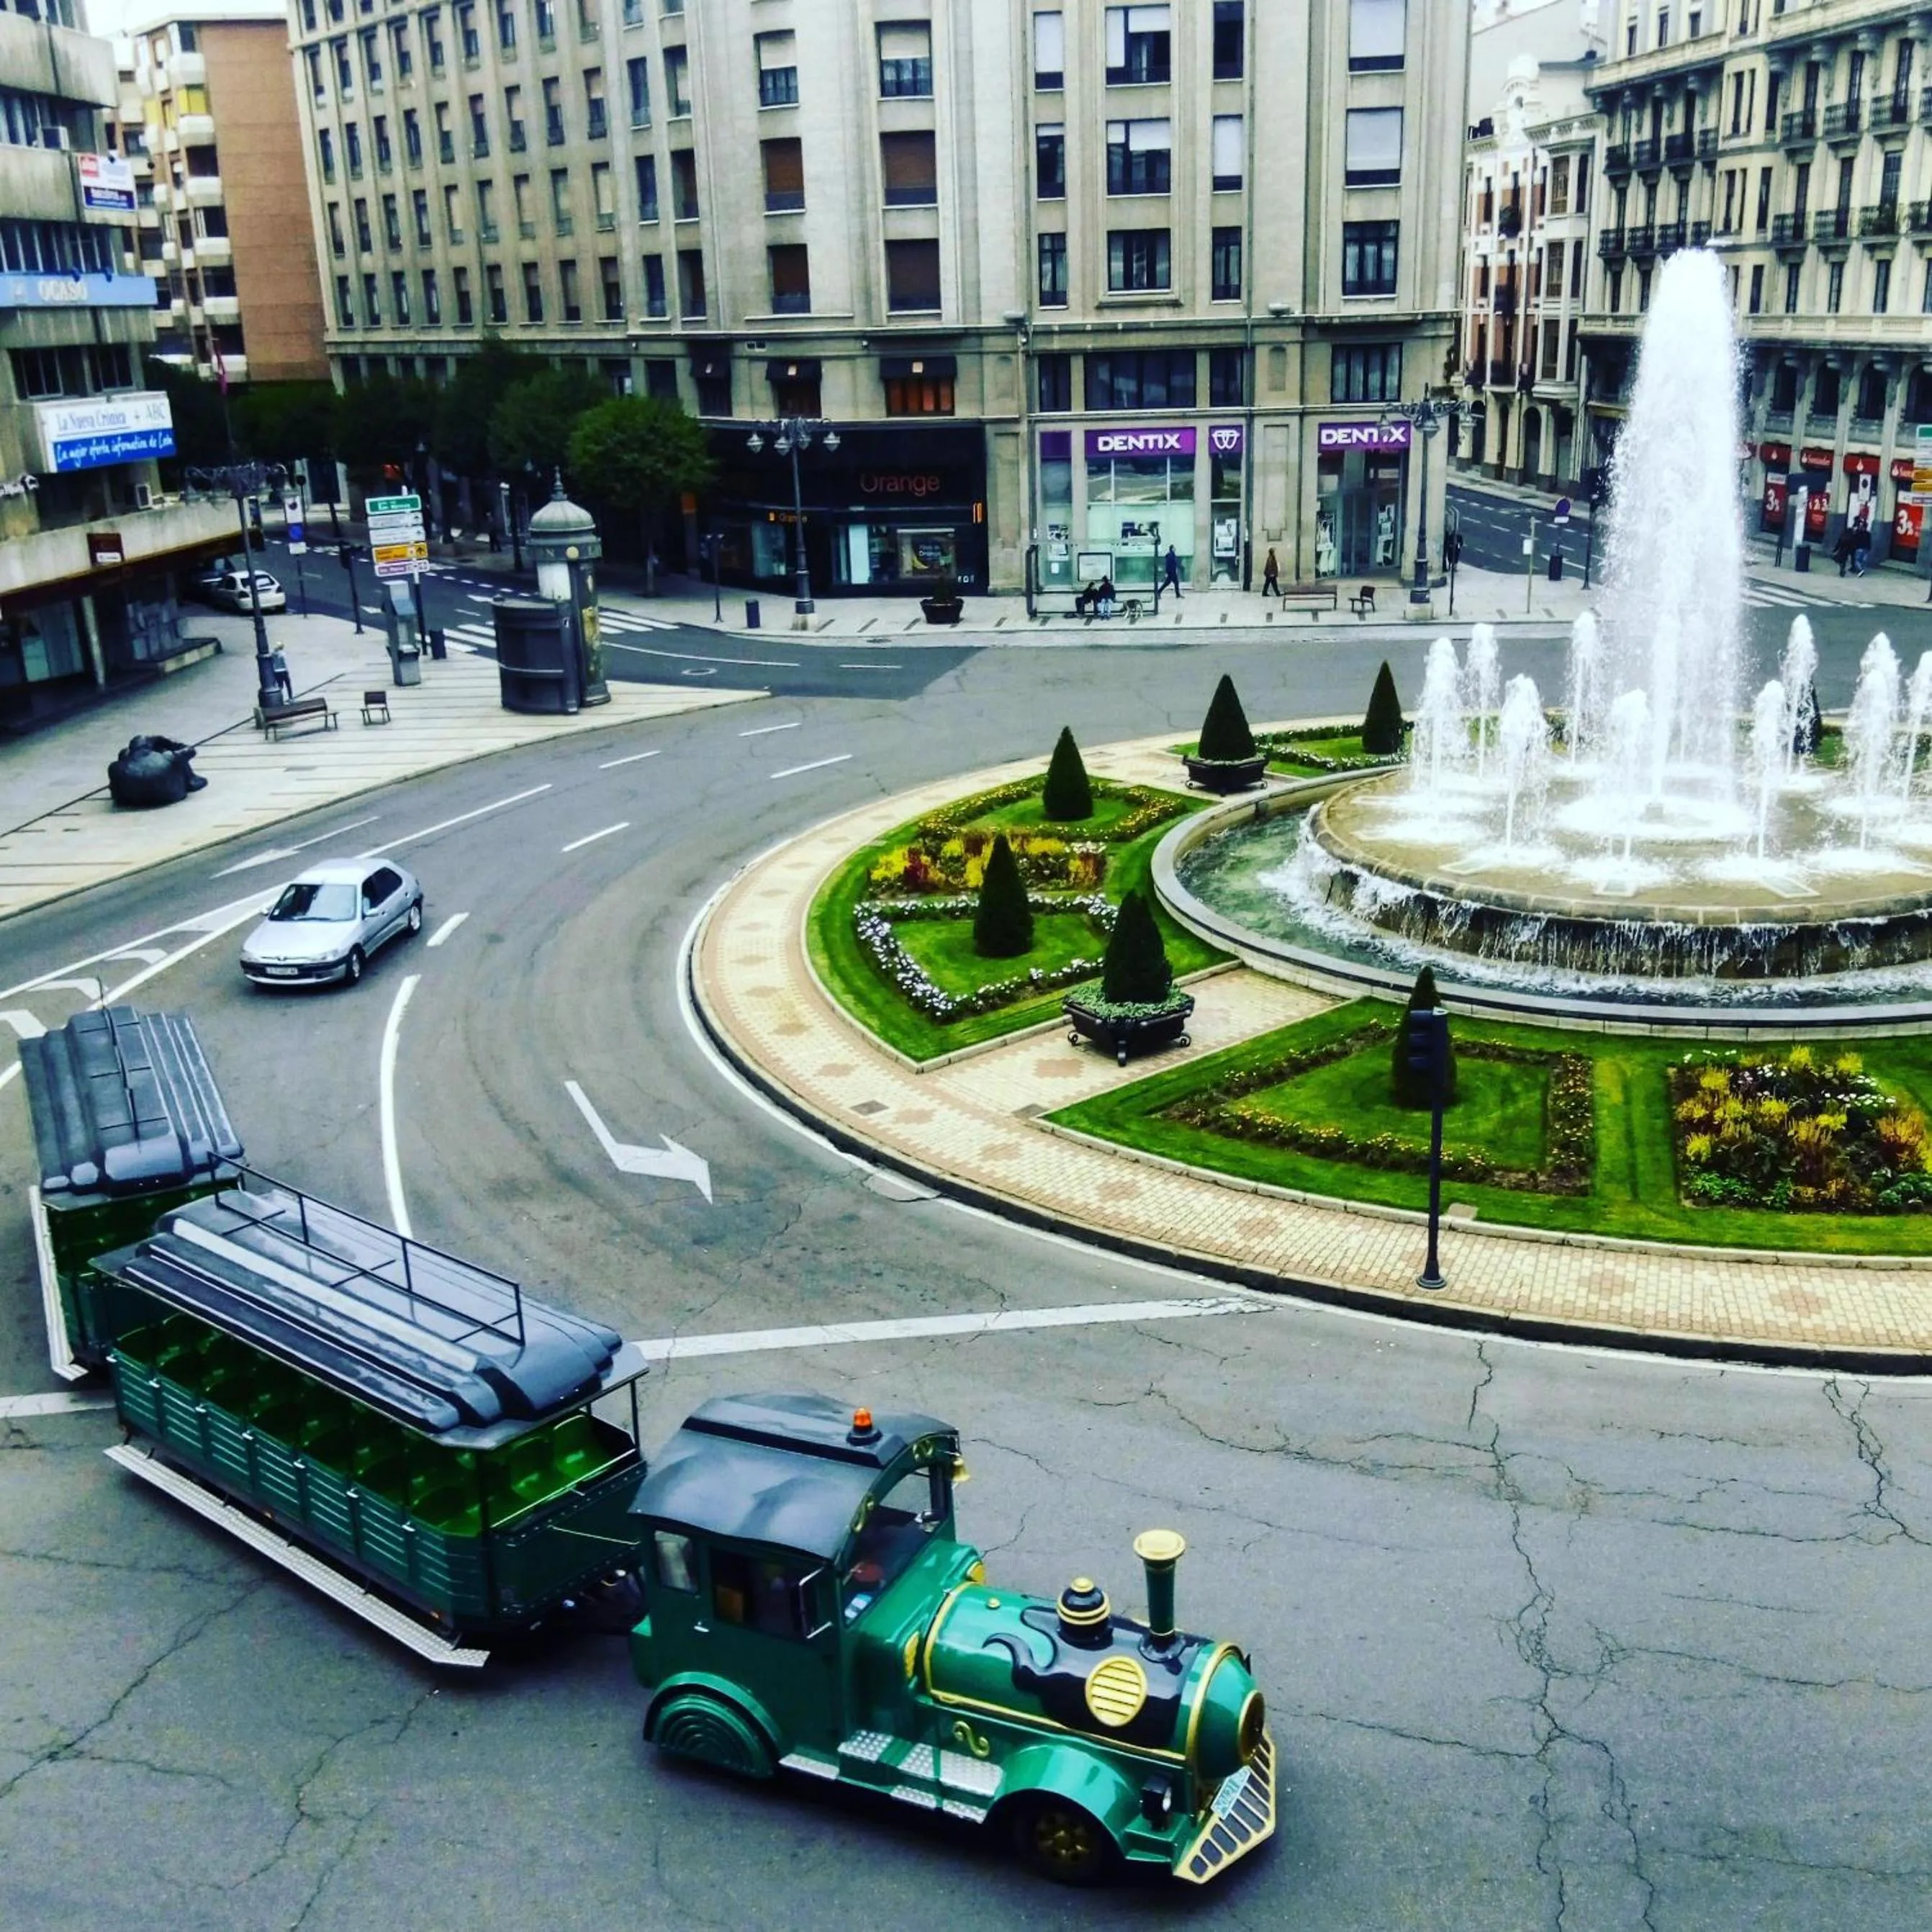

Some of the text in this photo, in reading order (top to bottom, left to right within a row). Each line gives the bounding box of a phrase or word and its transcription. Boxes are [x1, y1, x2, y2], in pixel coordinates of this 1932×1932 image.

[38, 280, 88, 301] OCASO
[70, 411, 95, 430] Nueva
[1098, 433, 1181, 452] DENTIX
[860, 474, 940, 497] Orange
